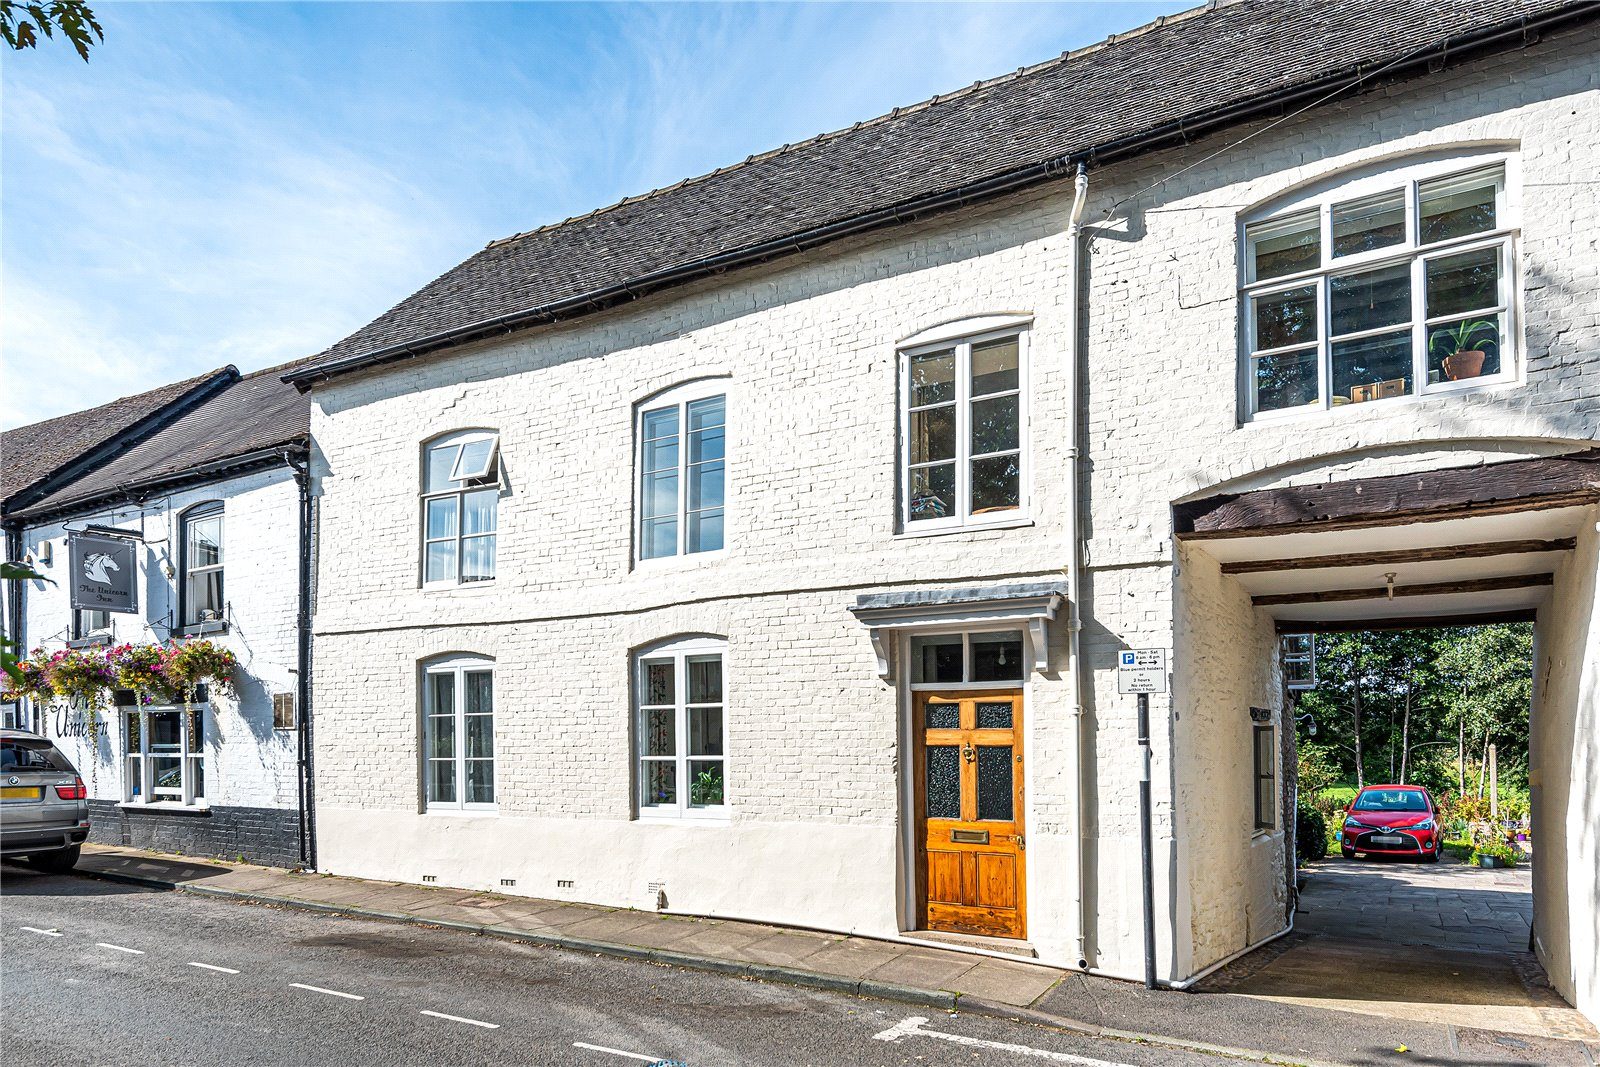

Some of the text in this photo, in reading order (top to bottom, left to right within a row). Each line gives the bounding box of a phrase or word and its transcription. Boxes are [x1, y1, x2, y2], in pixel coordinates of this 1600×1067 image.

[98, 587, 128, 595] Unicorn
[96, 594, 113, 602] Inn
[1125, 654, 1133, 663] P
[49, 704, 109, 738] Unicrn
